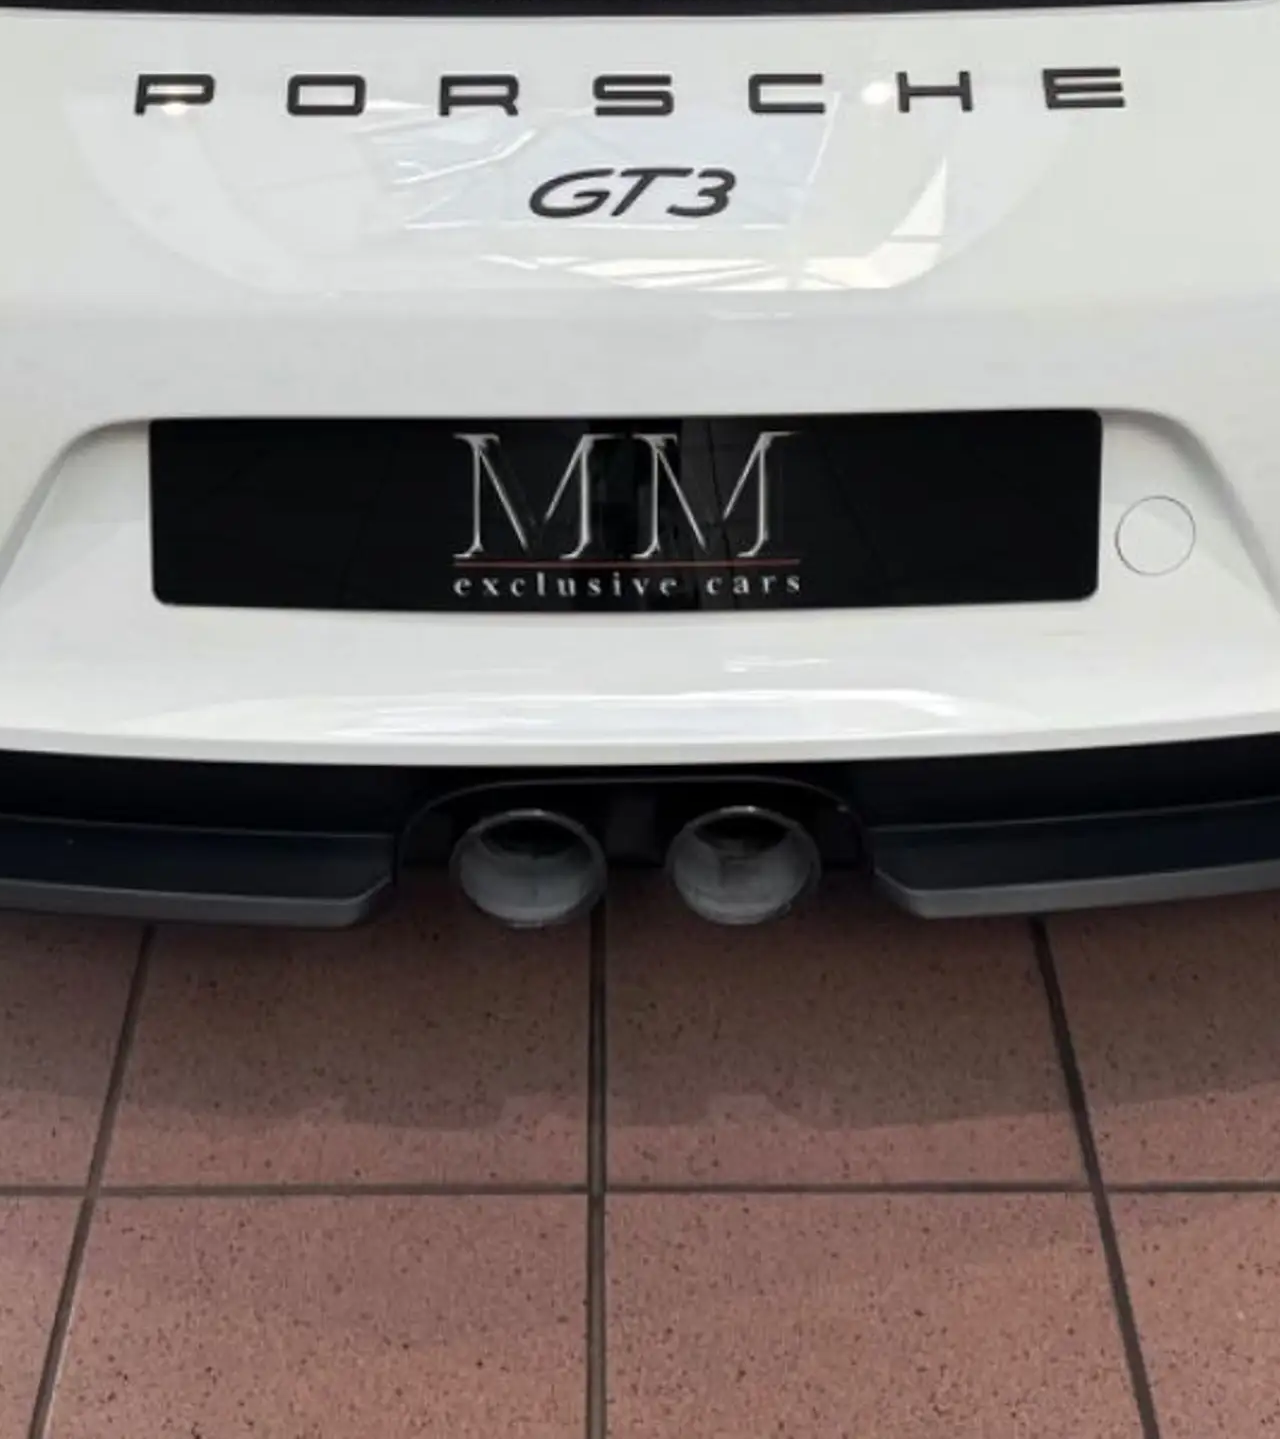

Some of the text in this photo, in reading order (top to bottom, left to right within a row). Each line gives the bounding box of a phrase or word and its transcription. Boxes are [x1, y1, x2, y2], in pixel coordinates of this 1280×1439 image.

[134, 67, 1126, 117] PORSCHE
[528, 166, 737, 219] GT3
[453, 430, 800, 559] MM
[453, 571, 801, 597] exclusive cars
